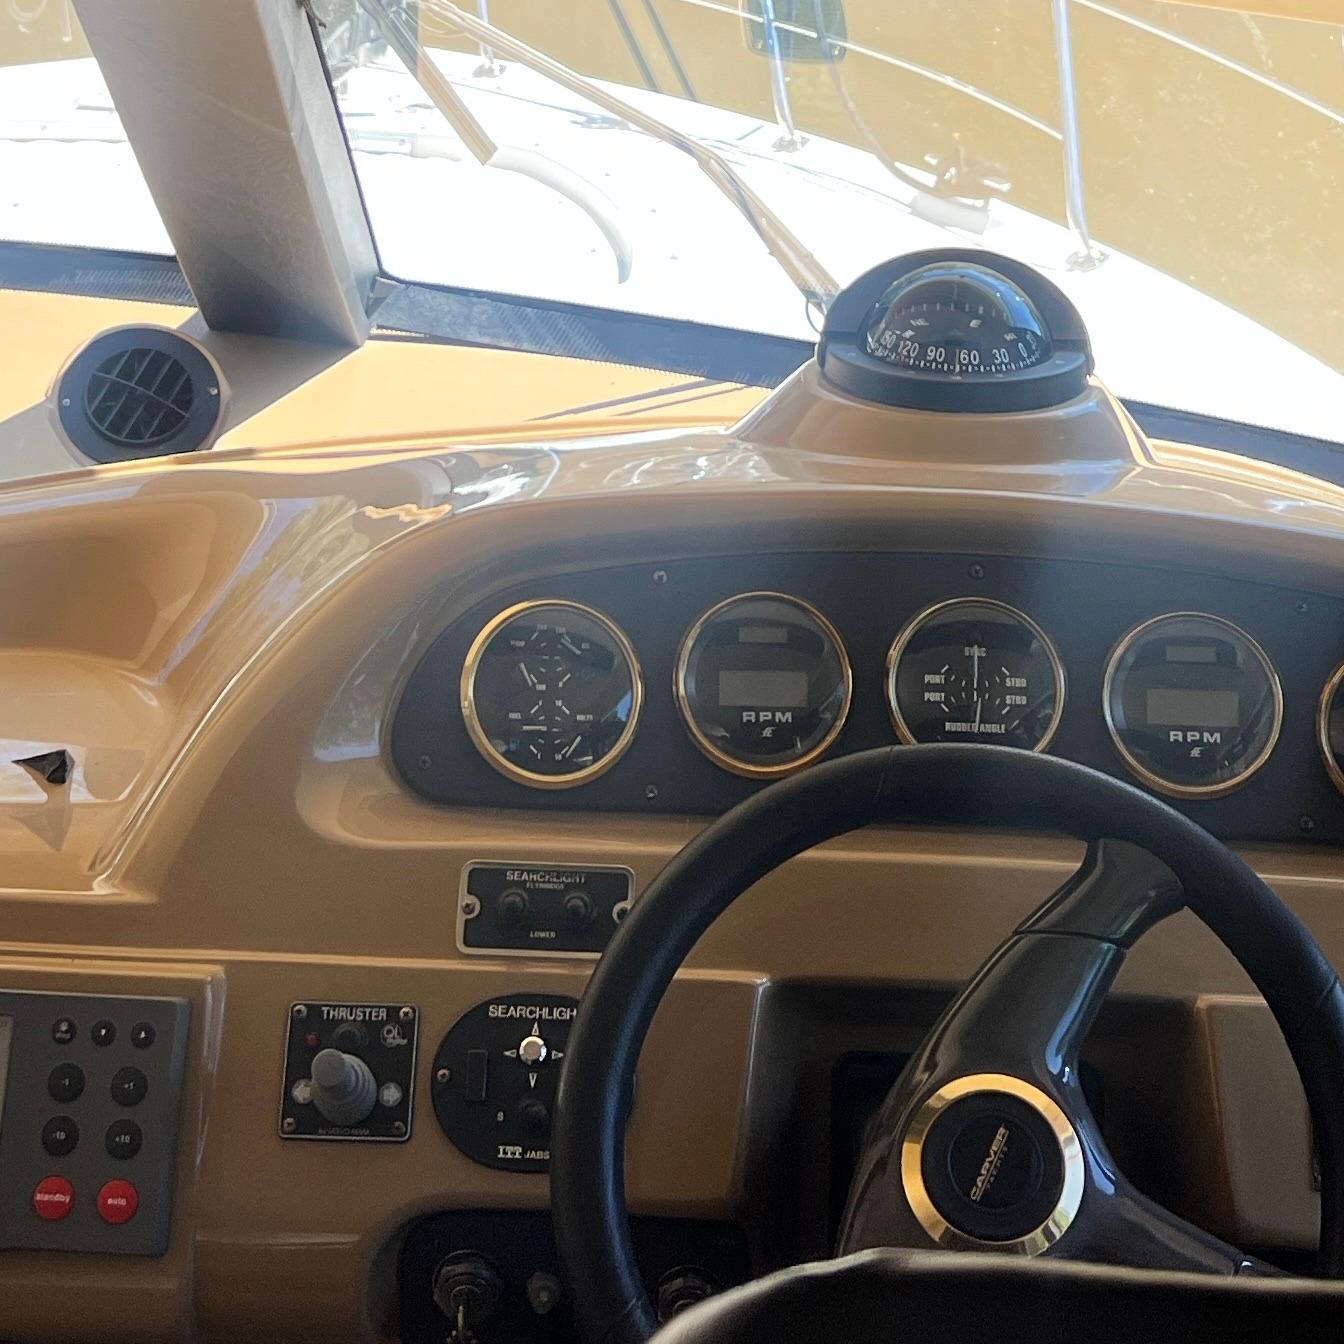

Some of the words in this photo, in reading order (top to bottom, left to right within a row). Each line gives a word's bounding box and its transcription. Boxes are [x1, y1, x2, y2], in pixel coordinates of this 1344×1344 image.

[897, 340, 920, 358] 120
[926, 346, 946, 363] 90
[960, 349, 980, 365] 60
[992, 348, 1010, 364] 30
[924, 674, 946, 684] PORT
[1006, 677, 1027, 688] STBD
[924, 692, 946, 702] PORT
[1006, 695, 1027, 705] STBD
[742, 711, 793, 723] RPM
[979, 723, 1006, 734] ANGLE
[1169, 730, 1221, 744] RPM
[505, 870, 587, 884] SEARCHLIGHT
[529, 930, 556, 939] LOWER
[321, 1006, 387, 1021] THRUSTER
[488, 1004, 577, 1020] SEARCHLIGH
[497, 1145, 523, 1158] ITT
[524, 1150, 551, 1160] JABS
[970, 1126, 1006, 1201] CARVER
[35, 1192, 71, 1204] standby
[107, 1197, 127, 1206] auto
